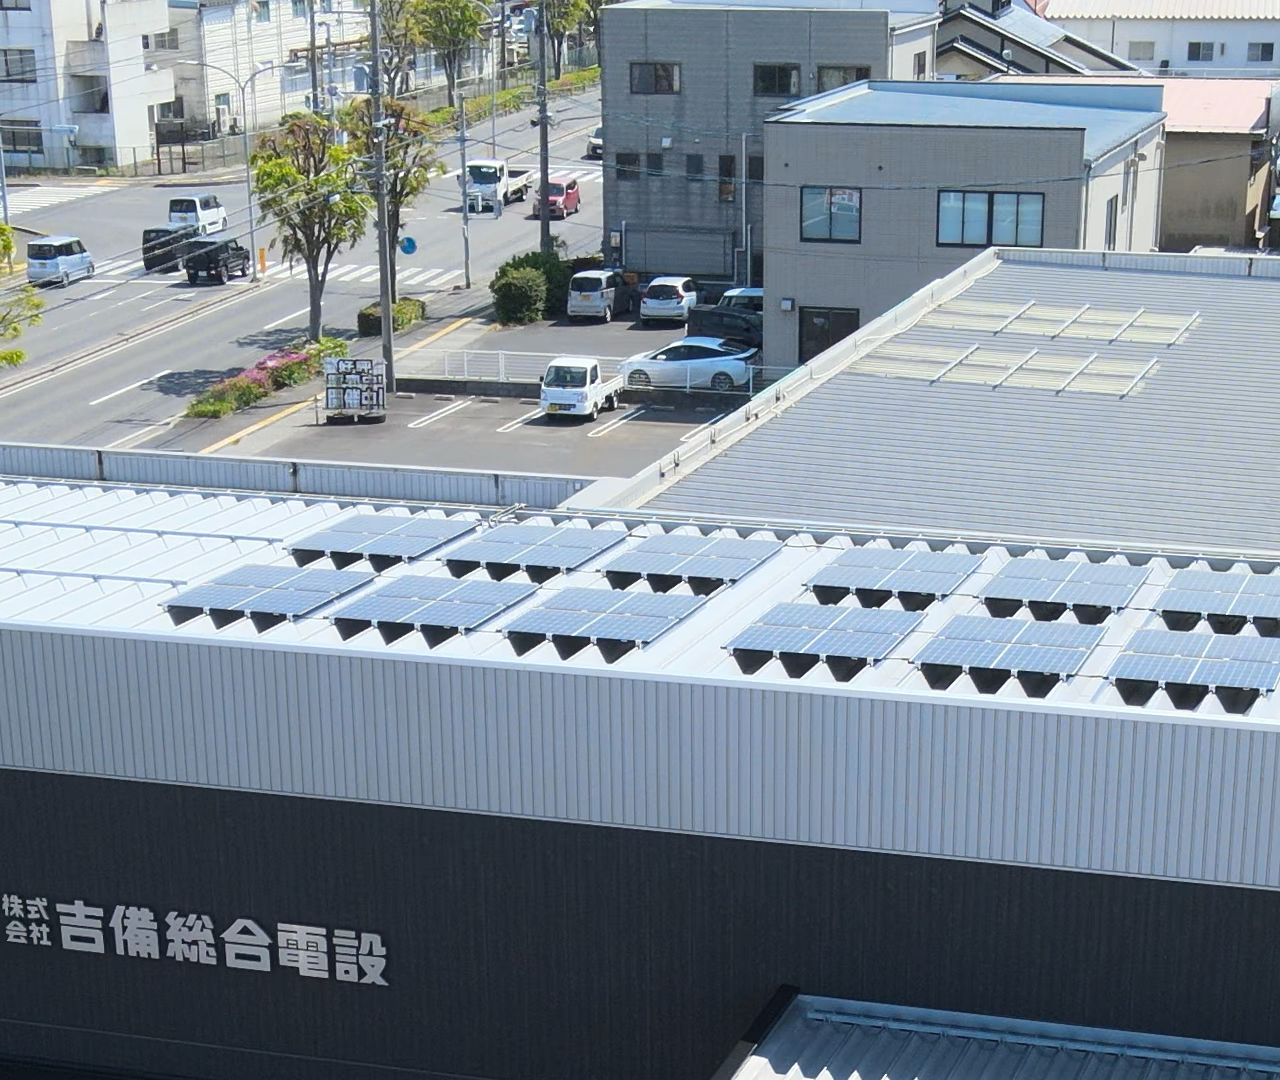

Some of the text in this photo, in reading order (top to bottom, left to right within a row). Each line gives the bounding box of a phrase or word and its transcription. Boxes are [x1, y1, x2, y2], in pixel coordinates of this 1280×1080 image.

[1, 893, 50, 920] 株式
[5, 920, 52, 946] 会社
[56, 900, 389, 986] 吉備総合電設
